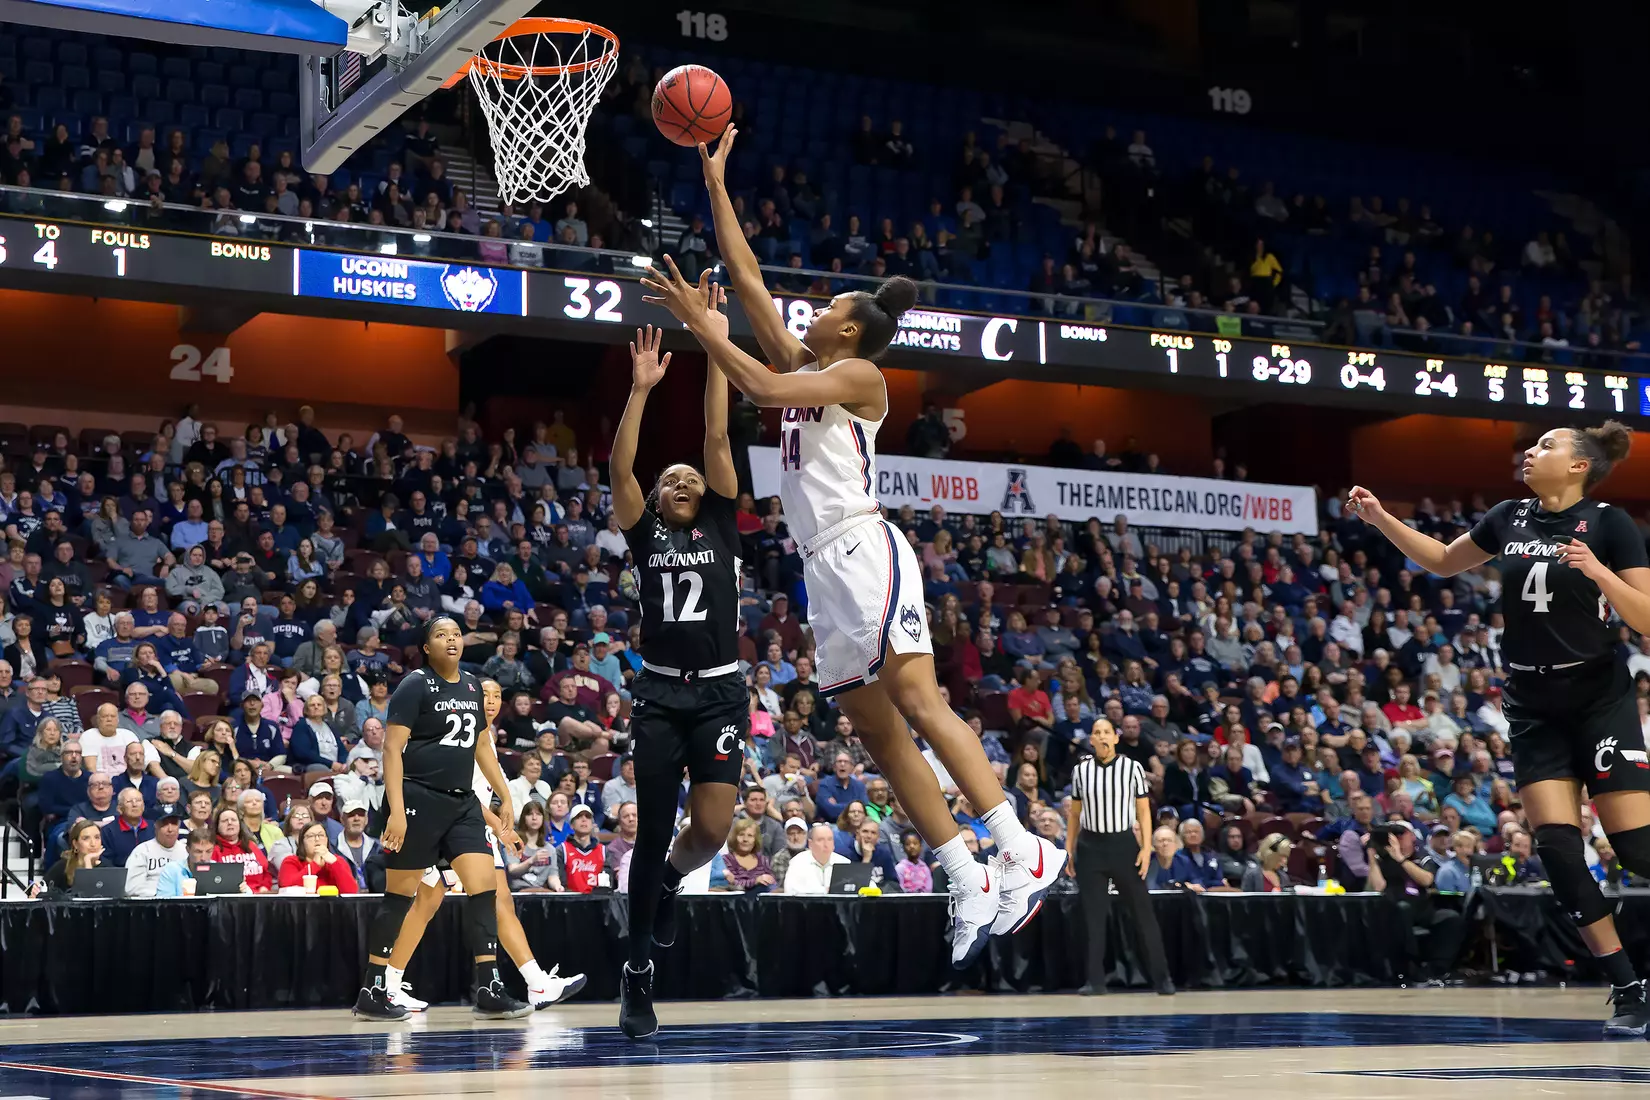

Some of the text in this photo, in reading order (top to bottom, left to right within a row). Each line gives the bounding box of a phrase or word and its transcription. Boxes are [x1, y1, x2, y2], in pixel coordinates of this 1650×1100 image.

[676, 10, 728, 41] 118
[1208, 86, 1251, 114] 119
[34, 223, 61, 240] TO
[91, 229, 150, 249] FOULS
[33, 240, 58, 270] 4
[112, 248, 126, 277] 1
[211, 241, 271, 261] BONUS
[341, 258, 409, 279] UCONN
[333, 277, 417, 300] HUSKIES
[563, 277, 623, 323] 32
[898, 313, 961, 332] CINNATI
[1061, 325, 1107, 342] BONUS
[889, 330, 961, 350] ARCATS
[1150, 333, 1194, 350] FOULS
[1212, 339, 1232, 353] TO
[170, 344, 235, 384] 24
[1166, 349, 1178, 373] 1
[1216, 353, 1228, 377] 1
[1252, 356, 1312, 385] 8-29
[1340, 364, 1386, 391] 0-4
[1415, 371, 1458, 397] 2-4
[1488, 378, 1505, 402] 5
[1522, 381, 1550, 406] 13
[1568, 385, 1586, 409] 2
[1611, 389, 1624, 412] 1
[783, 406, 824, 423] ONN
[943, 408, 967, 443] 5
[876, 472, 979, 502] CAN_WBB
[1057, 481, 1293, 522] THEAMERICAN.ORG/WBB
[648, 549, 715, 567] CINCINNATI
[1504, 541, 1562, 558] CINCINN
[660, 570, 708, 623] 12
[1521, 561, 1554, 613] 4
[243, 635, 265, 646] CONN
[272, 624, 305, 637] UCONN
[434, 699, 479, 712] CINCINNATI
[439, 713, 477, 749] 23
